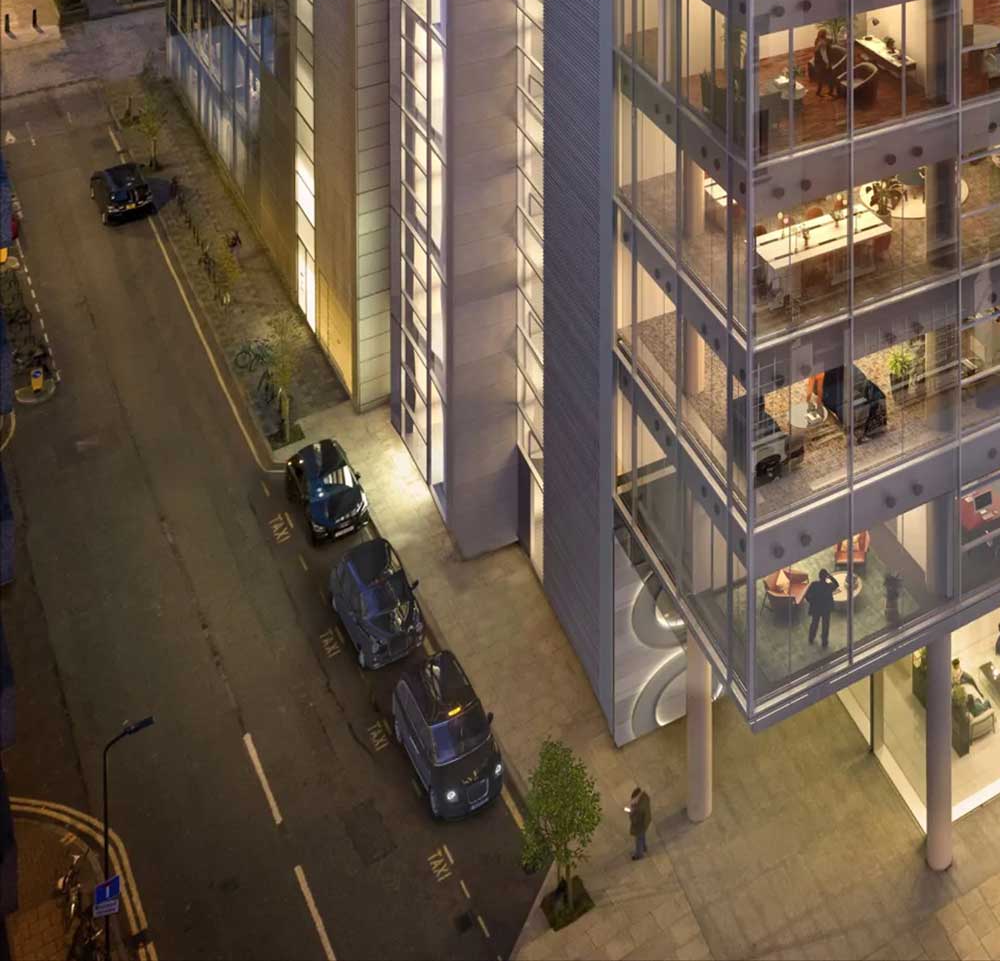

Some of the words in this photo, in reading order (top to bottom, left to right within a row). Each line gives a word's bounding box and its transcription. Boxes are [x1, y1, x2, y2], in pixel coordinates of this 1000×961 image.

[269, 513, 290, 543] TAXI
[319, 628, 341, 658] TAXI
[367, 720, 389, 751] TAXI
[427, 849, 452, 881] TAXI
